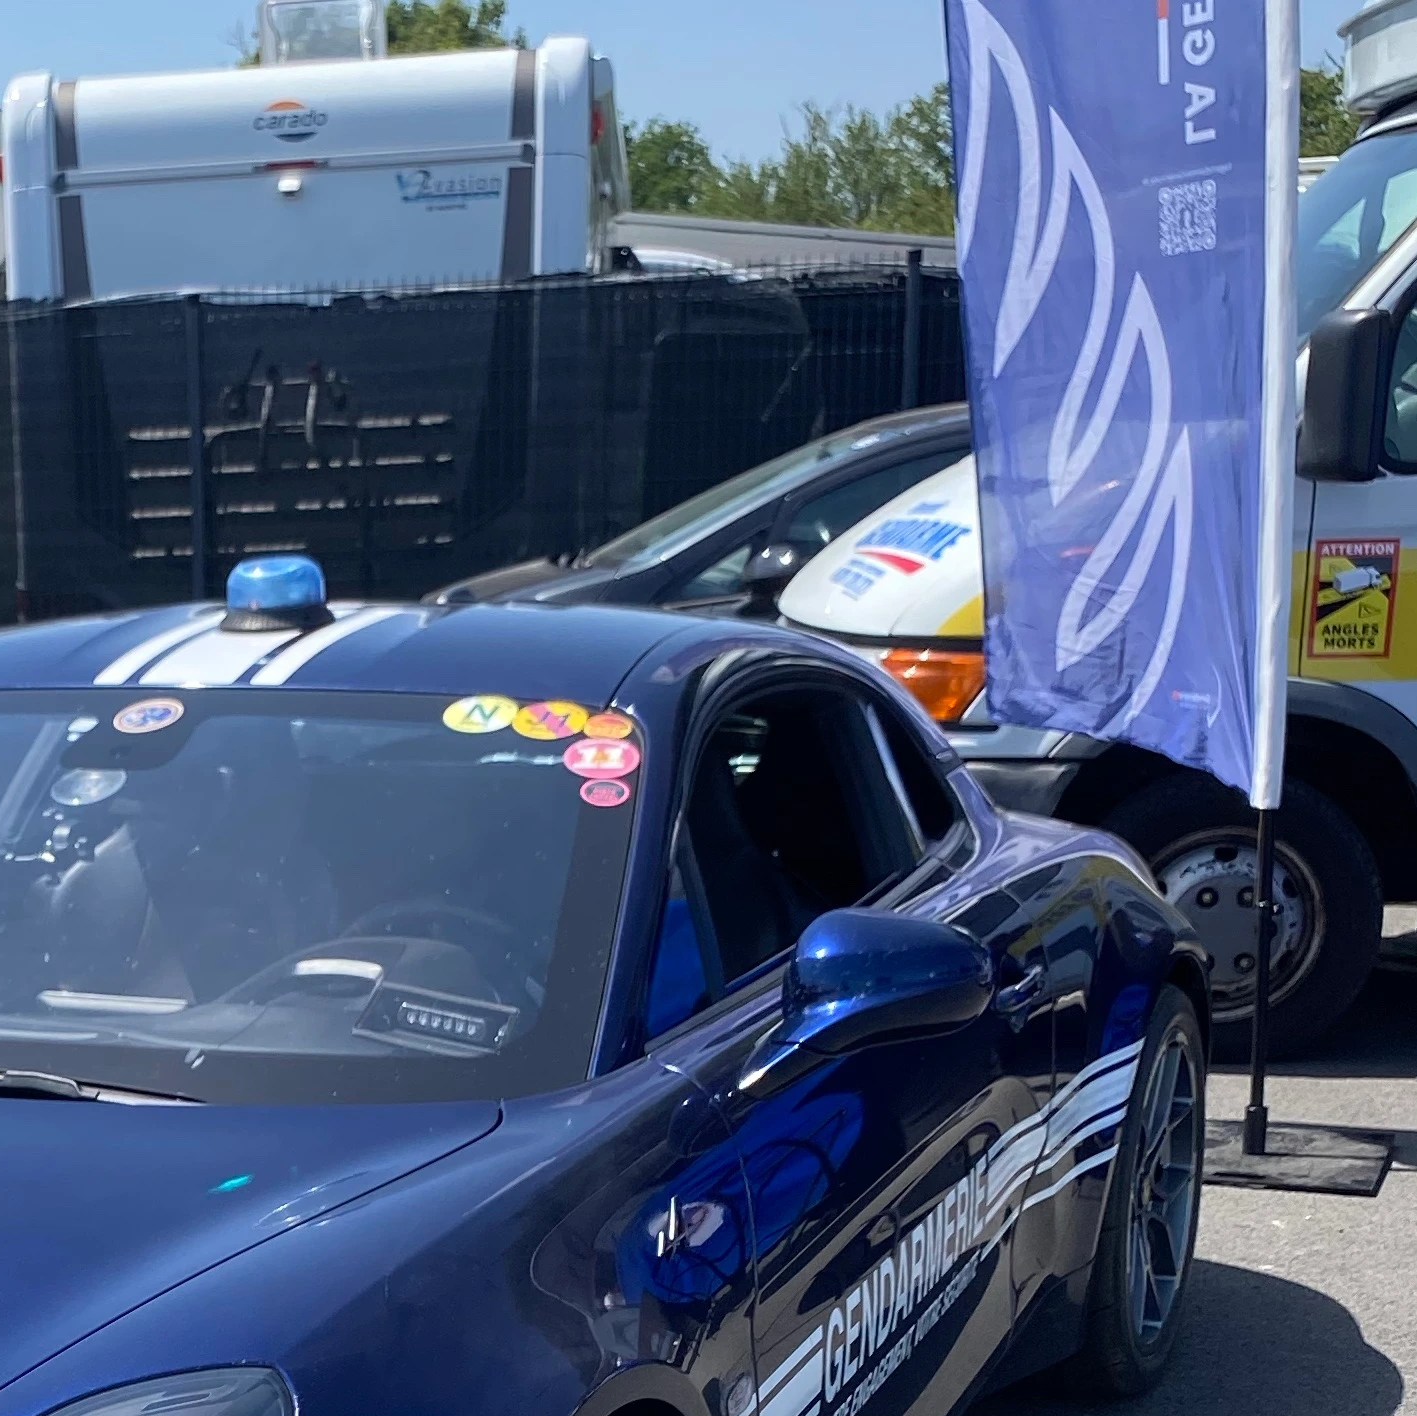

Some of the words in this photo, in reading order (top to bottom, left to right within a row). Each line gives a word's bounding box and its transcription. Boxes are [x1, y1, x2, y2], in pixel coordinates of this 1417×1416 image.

[253, 109, 329, 131] carado
[1321, 543, 1395, 556] ATTENTION
[1321, 623, 1379, 637] ANGLES
[1323, 636, 1375, 650] MORTS
[824, 1153, 987, 1403] GENDARMERIE
